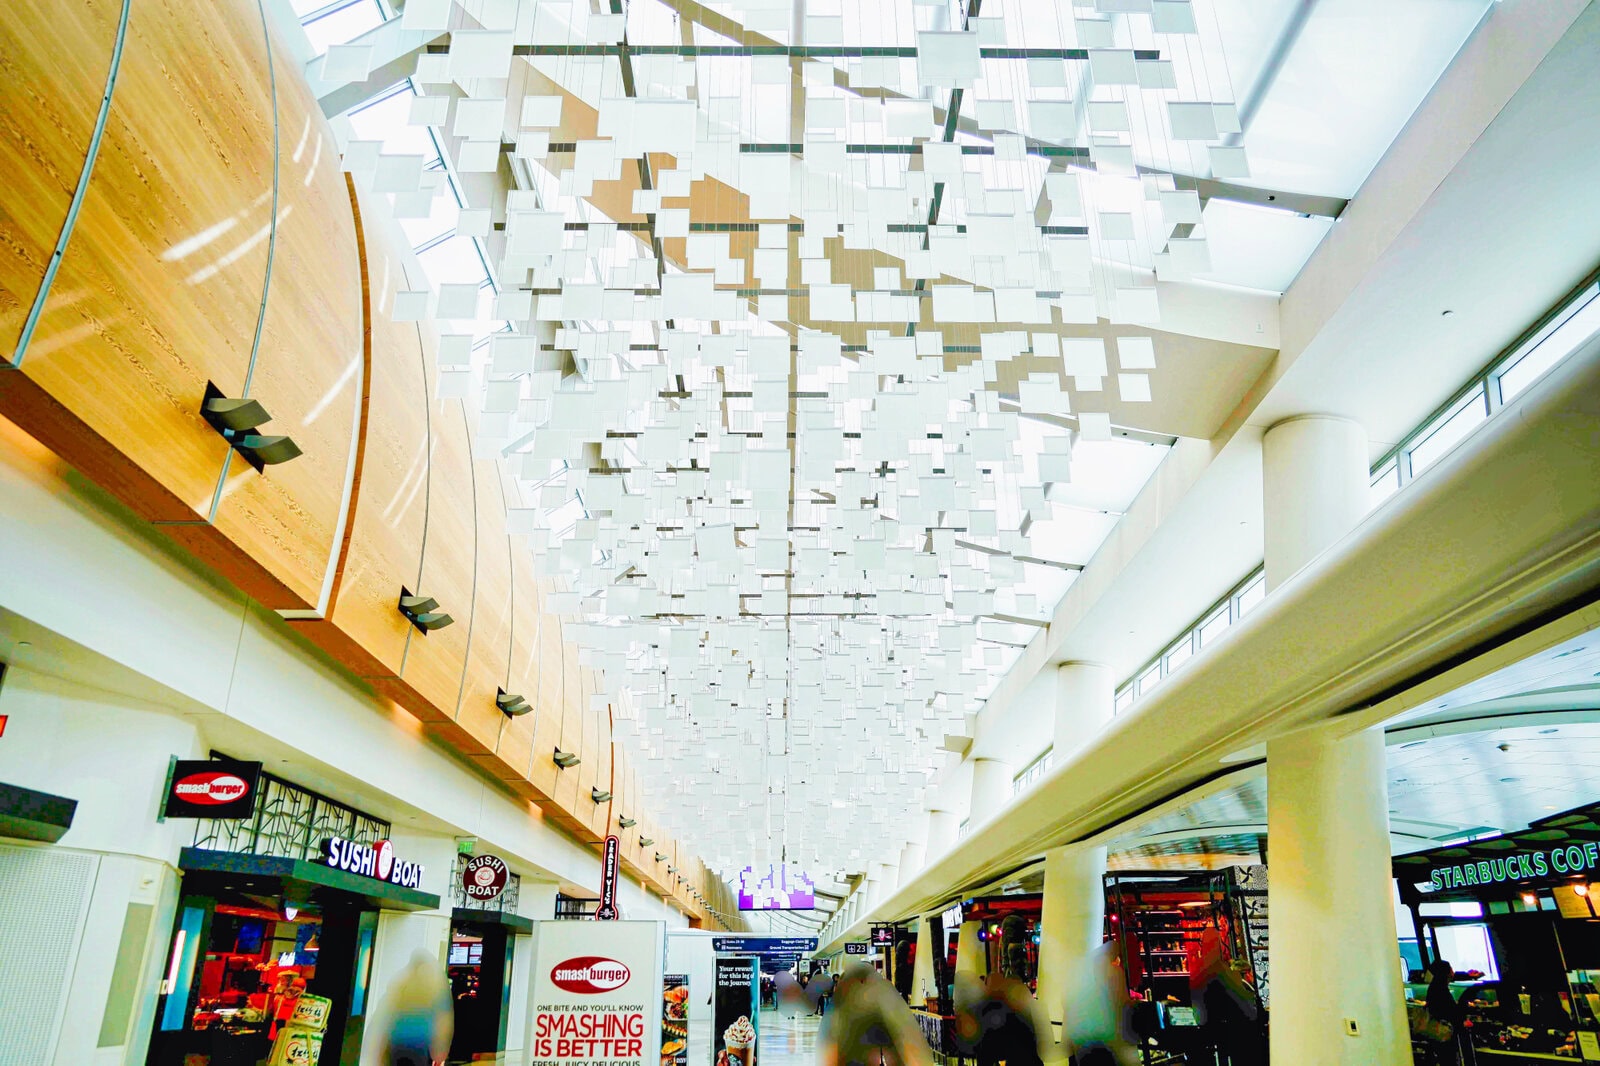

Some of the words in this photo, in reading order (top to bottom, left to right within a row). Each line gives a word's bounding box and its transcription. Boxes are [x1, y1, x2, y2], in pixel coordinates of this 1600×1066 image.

[176, 782, 243, 795] smashburger
[327, 836, 377, 877] SUSHI
[391, 857, 425, 888] BOAT
[468, 856, 504, 874] SUSHI
[607, 840, 615, 877] TRADER
[1431, 852, 1549, 891] STARBUCKS
[1551, 842, 1600, 873] COF
[468, 885, 500, 896] BOAT
[856, 944, 866, 952] 23
[555, 967, 627, 982] smashburger
[536, 1014, 643, 1038] SMASHING
[535, 1039, 552, 1057] IS
[556, 1039, 642, 1057] BETTER
